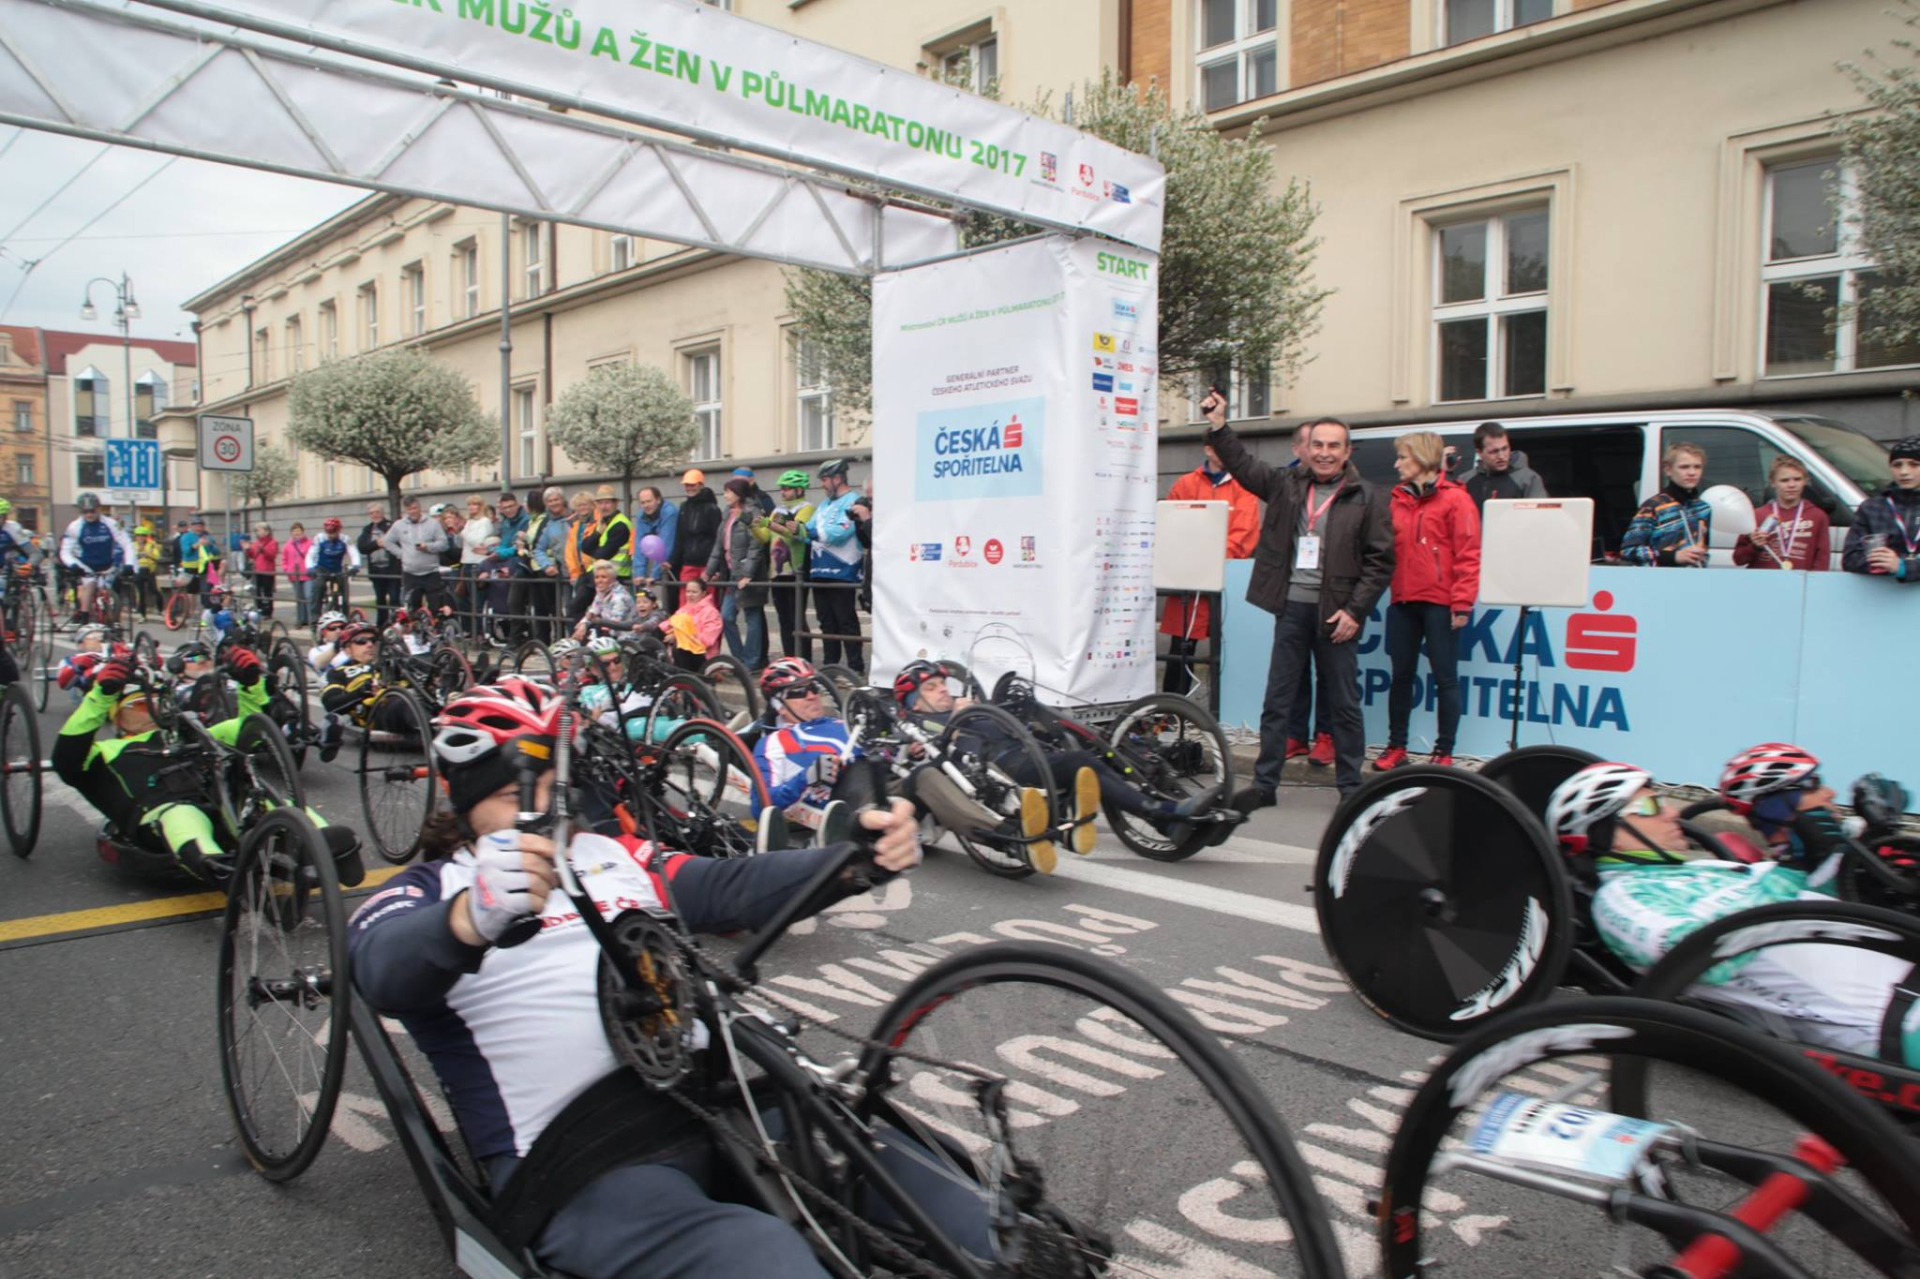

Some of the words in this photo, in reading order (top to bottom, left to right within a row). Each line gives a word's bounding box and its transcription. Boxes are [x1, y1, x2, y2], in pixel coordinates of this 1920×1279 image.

[457, 0, 581, 50] MUŽŮ
[590, 27, 620, 62] A
[629, 30, 701, 85] ŽEN
[710, 60, 732, 92] V
[741, 70, 962, 159] PŮLMARATONU
[970, 140, 1027, 178] 2017
[1097, 250, 1150, 281] START
[220, 442, 235, 455] 30
[934, 420, 1001, 455] ČESKÁ
[933, 453, 1023, 479] SPOŘITELNA
